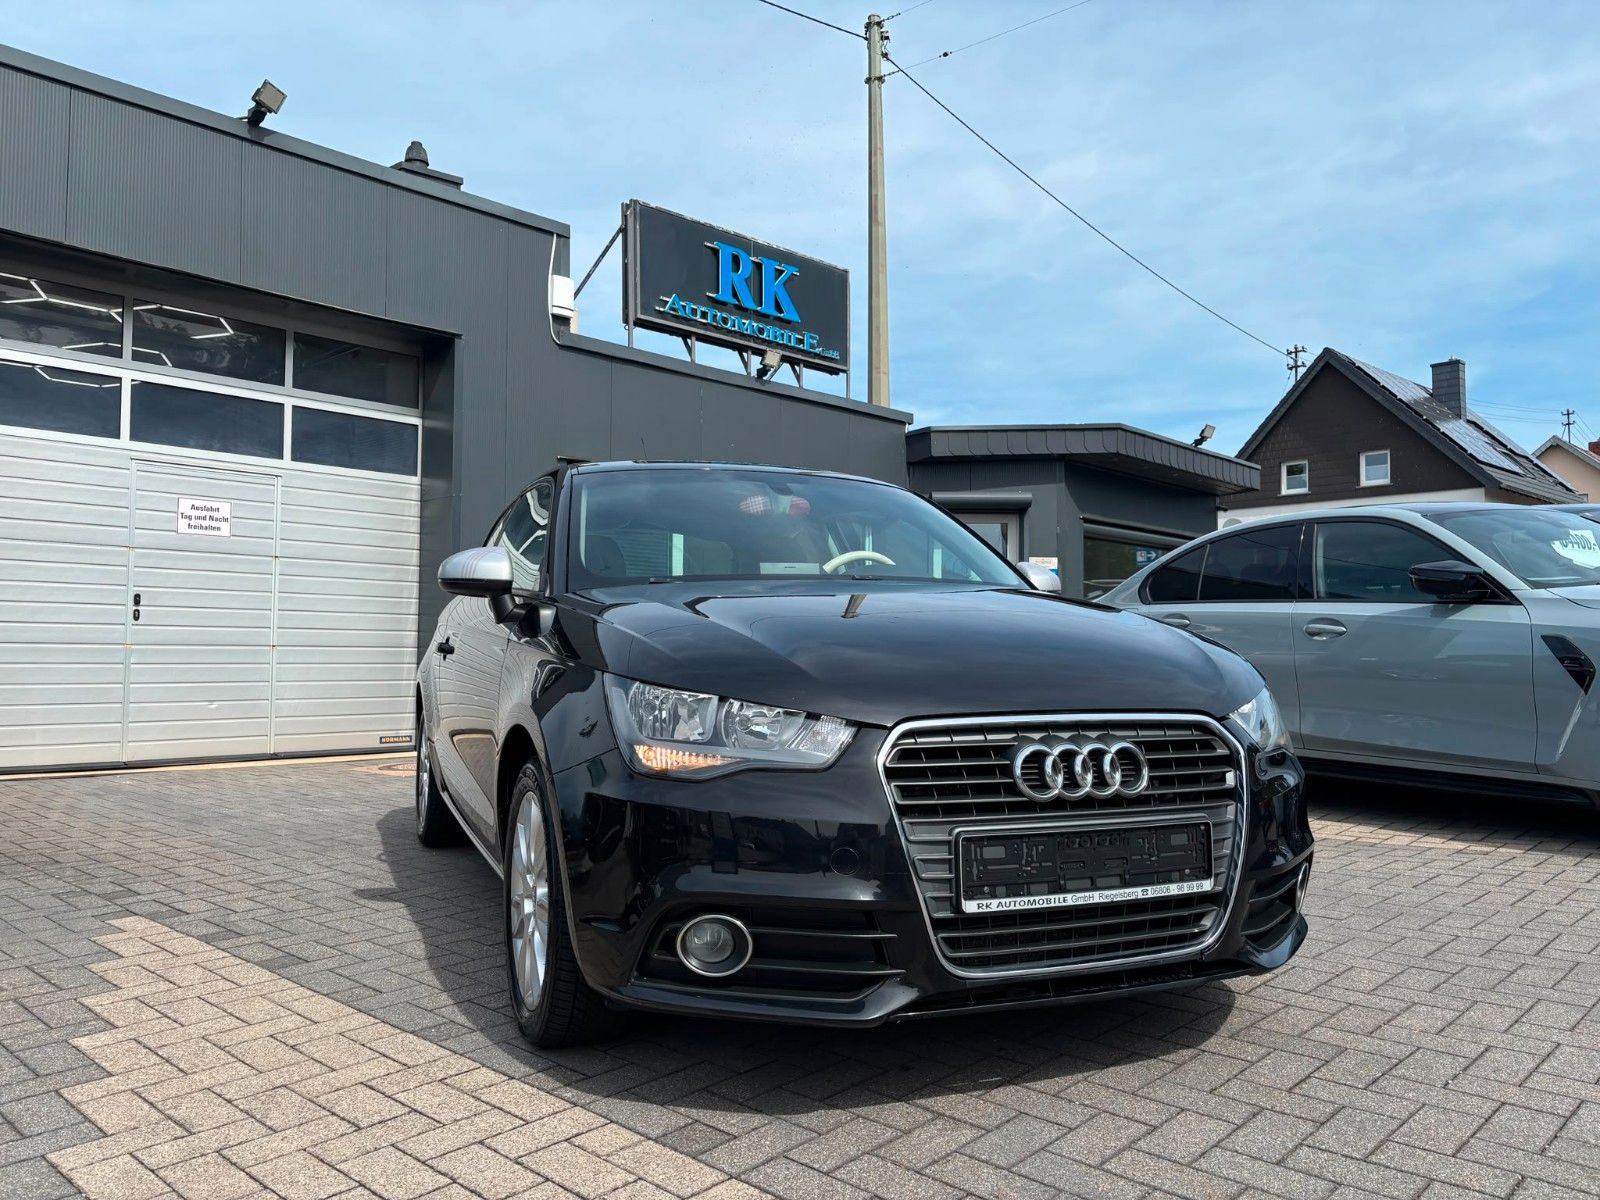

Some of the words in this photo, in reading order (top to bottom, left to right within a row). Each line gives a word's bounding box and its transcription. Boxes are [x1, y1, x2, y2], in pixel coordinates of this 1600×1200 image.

[704, 241, 801, 323] RK
[655, 293, 819, 353] AUTOMOBILE
[190, 504, 220, 513] Ausfahrt
[180, 513, 193, 521] Tag
[208, 514, 229, 523] Nacht
[187, 522, 222, 532] freihalten
[976, 902, 993, 911] RK
[996, 897, 1069, 909] AUTOMOBILE
[1070, 893, 1095, 904] GmbH
[1098, 890, 1139, 901] Riegelsberg
[1150, 886, 1171, 896] 06806
